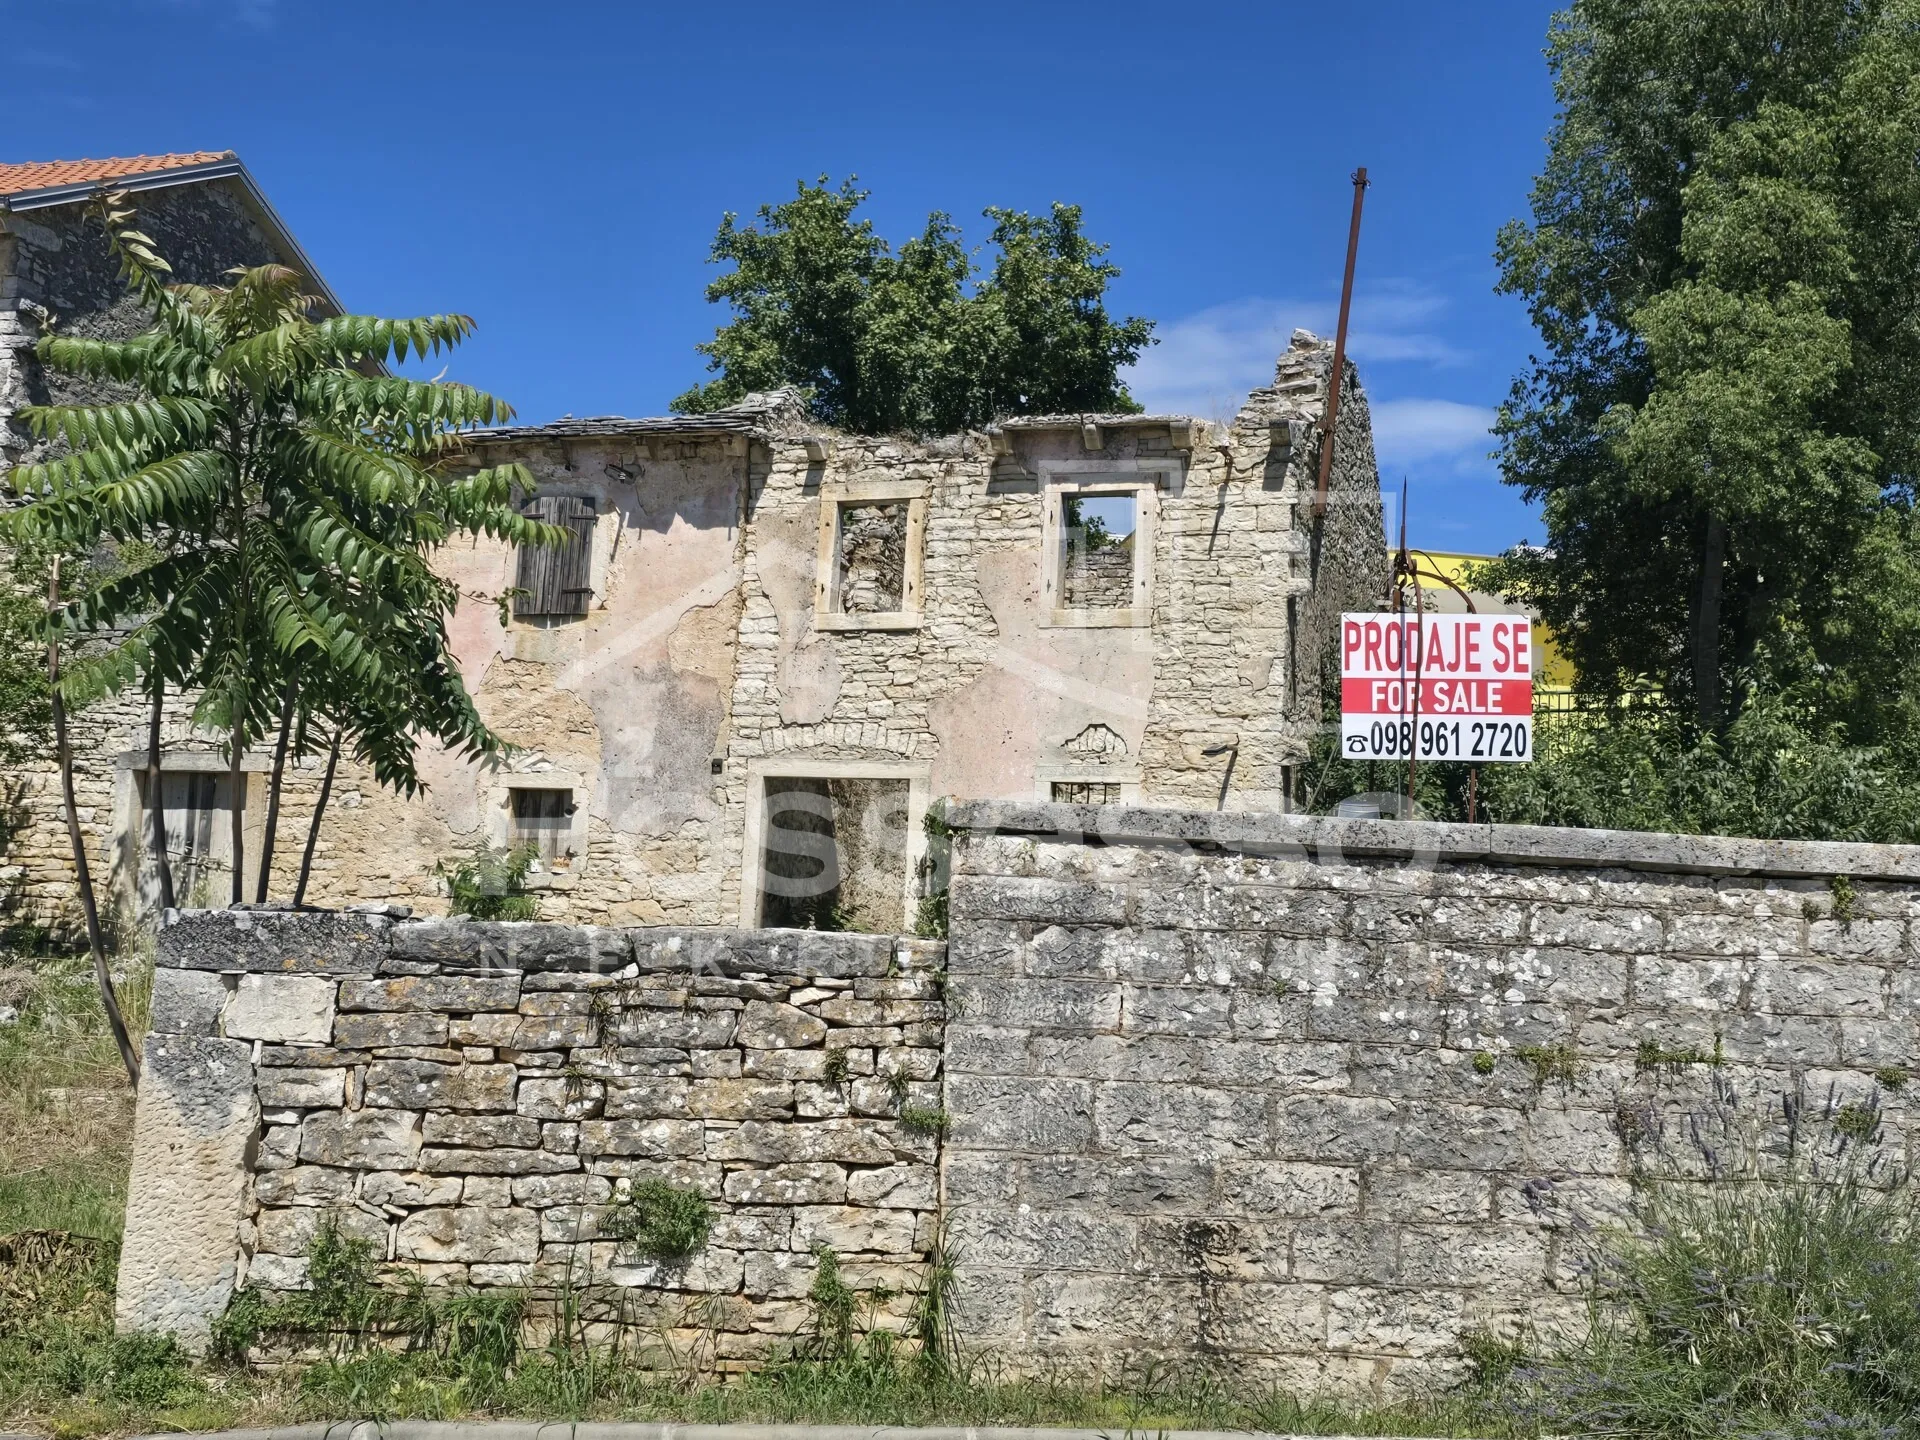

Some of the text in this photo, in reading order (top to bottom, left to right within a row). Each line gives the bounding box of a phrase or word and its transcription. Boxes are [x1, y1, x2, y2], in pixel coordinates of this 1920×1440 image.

[1344, 621, 1529, 673] PRODAJE SE
[1371, 681, 1503, 713] FOR SALE
[1370, 720, 1528, 758] 098 961 2720
